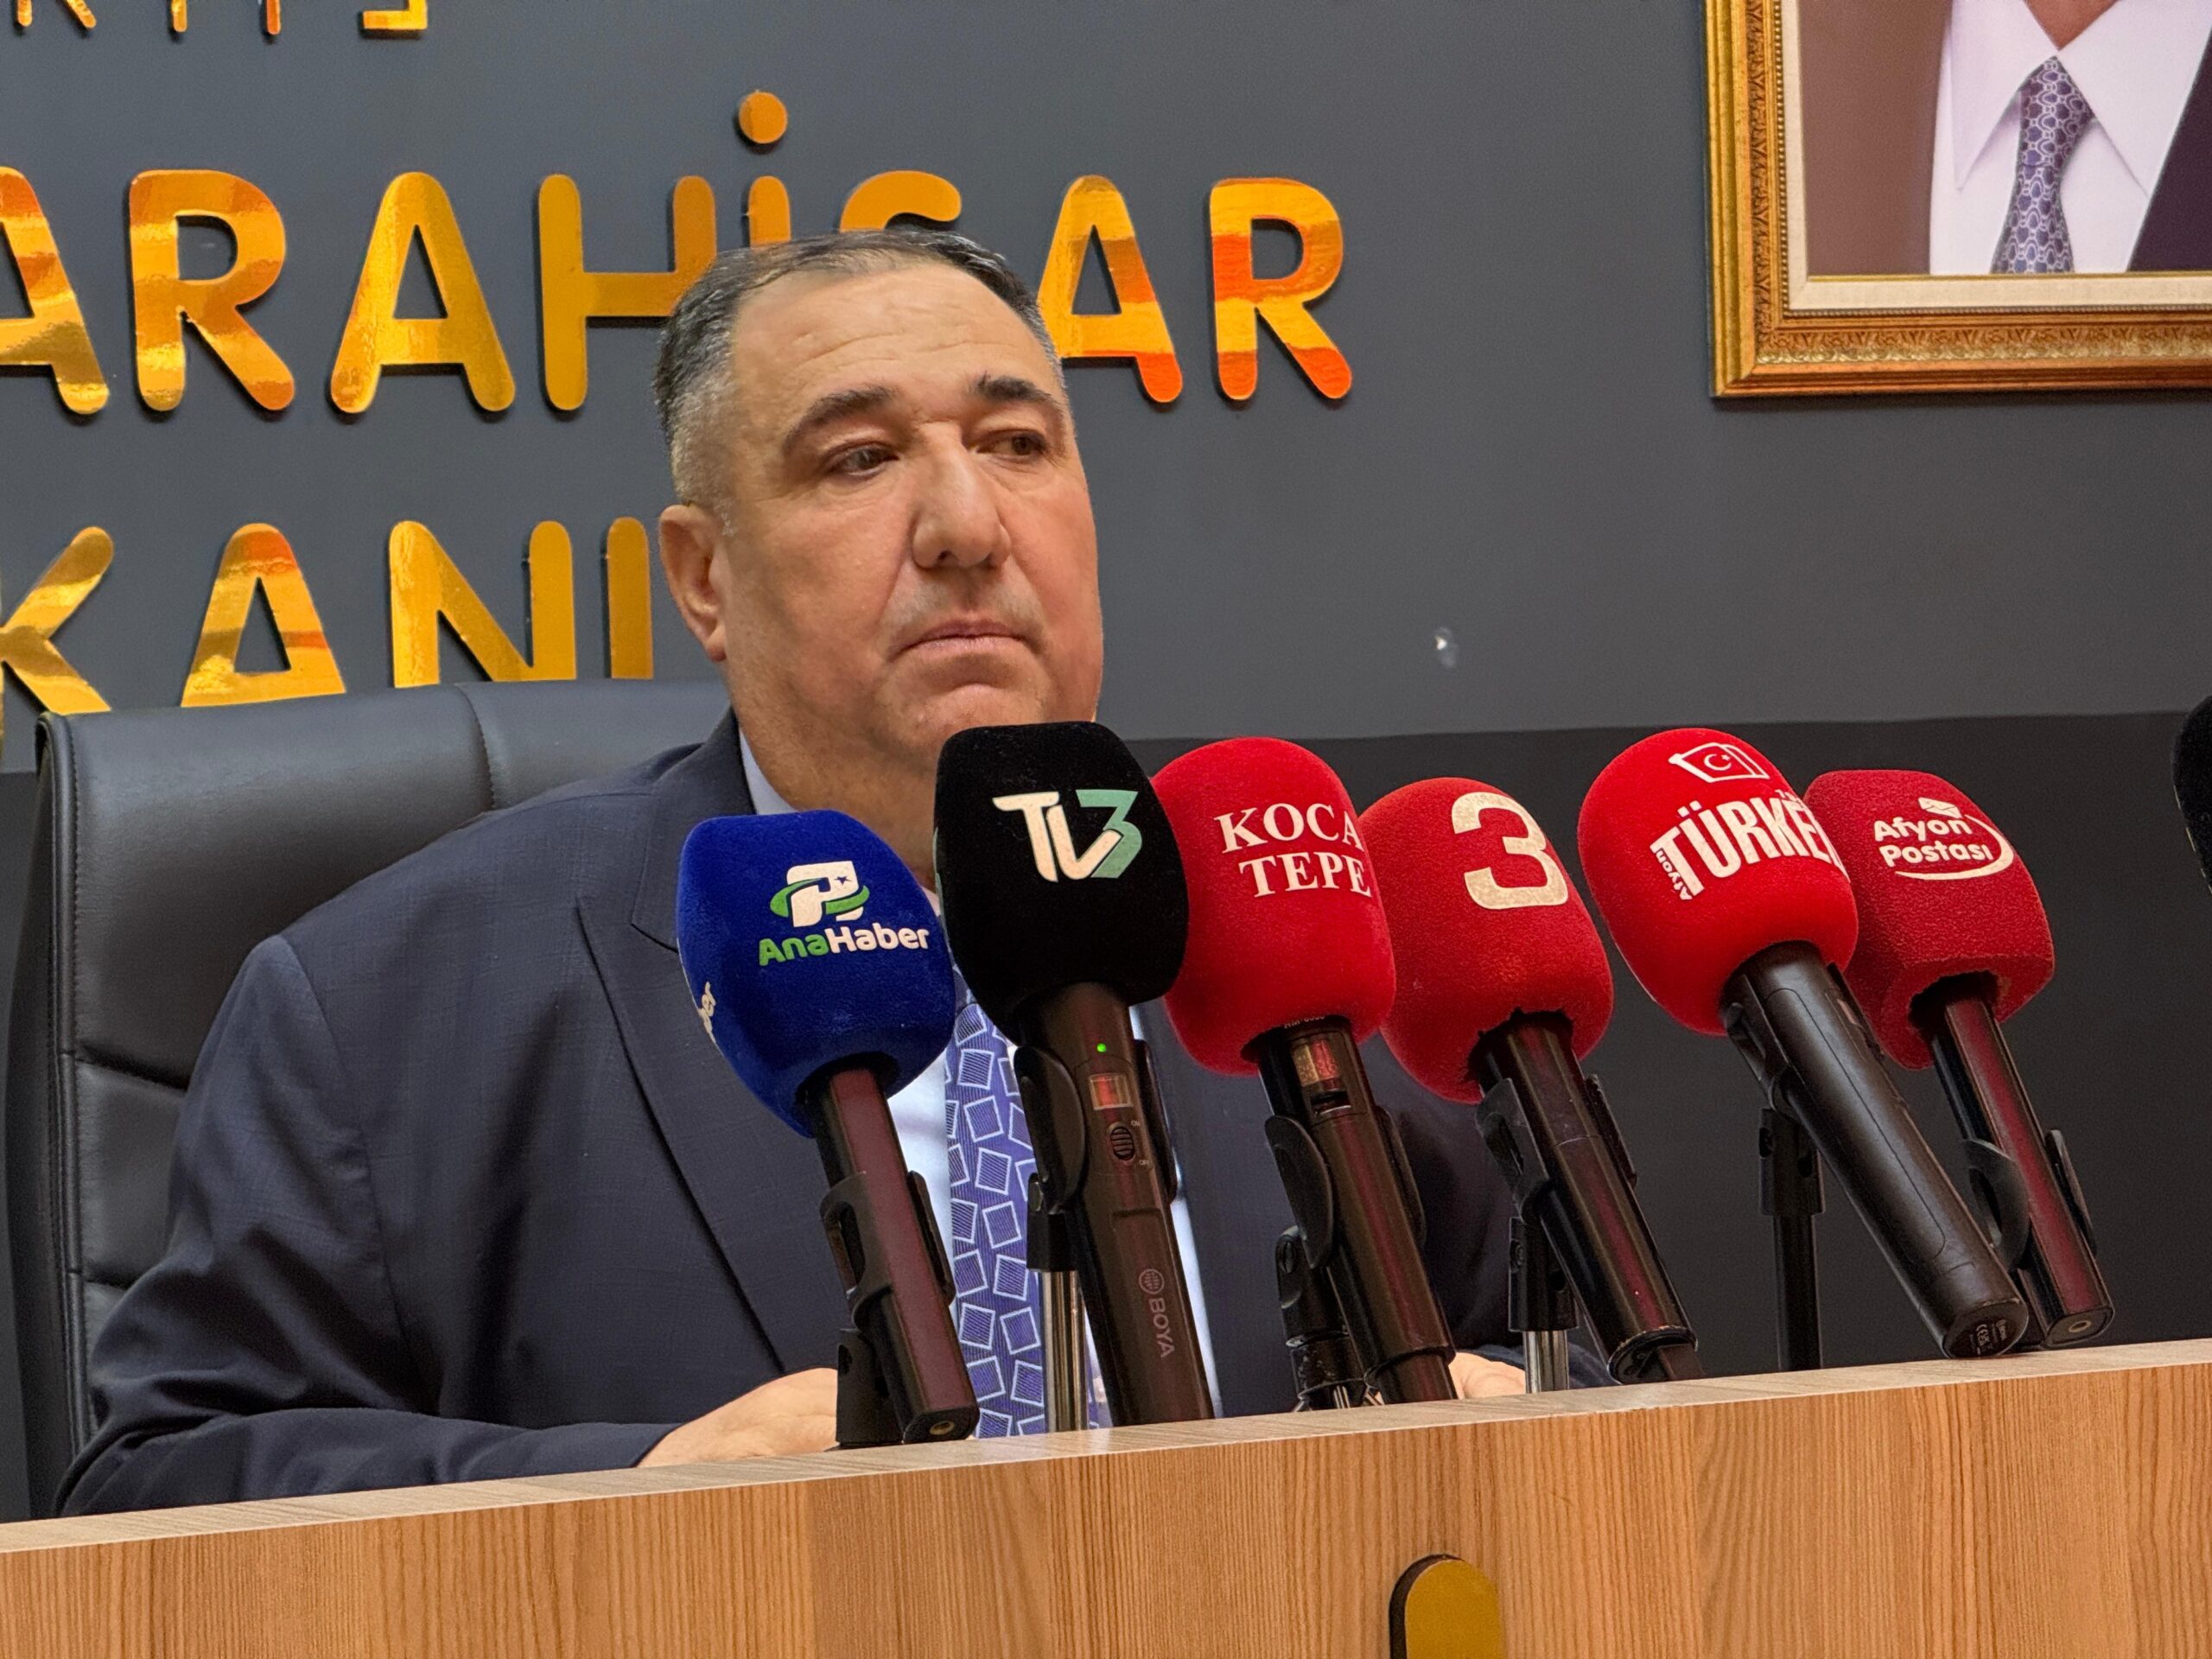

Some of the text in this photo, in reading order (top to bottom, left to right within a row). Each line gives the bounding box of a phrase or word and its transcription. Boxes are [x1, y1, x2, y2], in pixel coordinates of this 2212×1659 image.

[1213, 803, 1364, 855] KOCA
[1451, 791, 1569, 910] 3
[1649, 798, 1851, 897] TÜRKE
[1873, 816, 1973, 842] Afyon
[1238, 851, 1372, 898] TEPE
[1878, 840, 1994, 868] Postası
[759, 922, 930, 967] AnaHaber
[1148, 1298, 1175, 1357] BOYA
